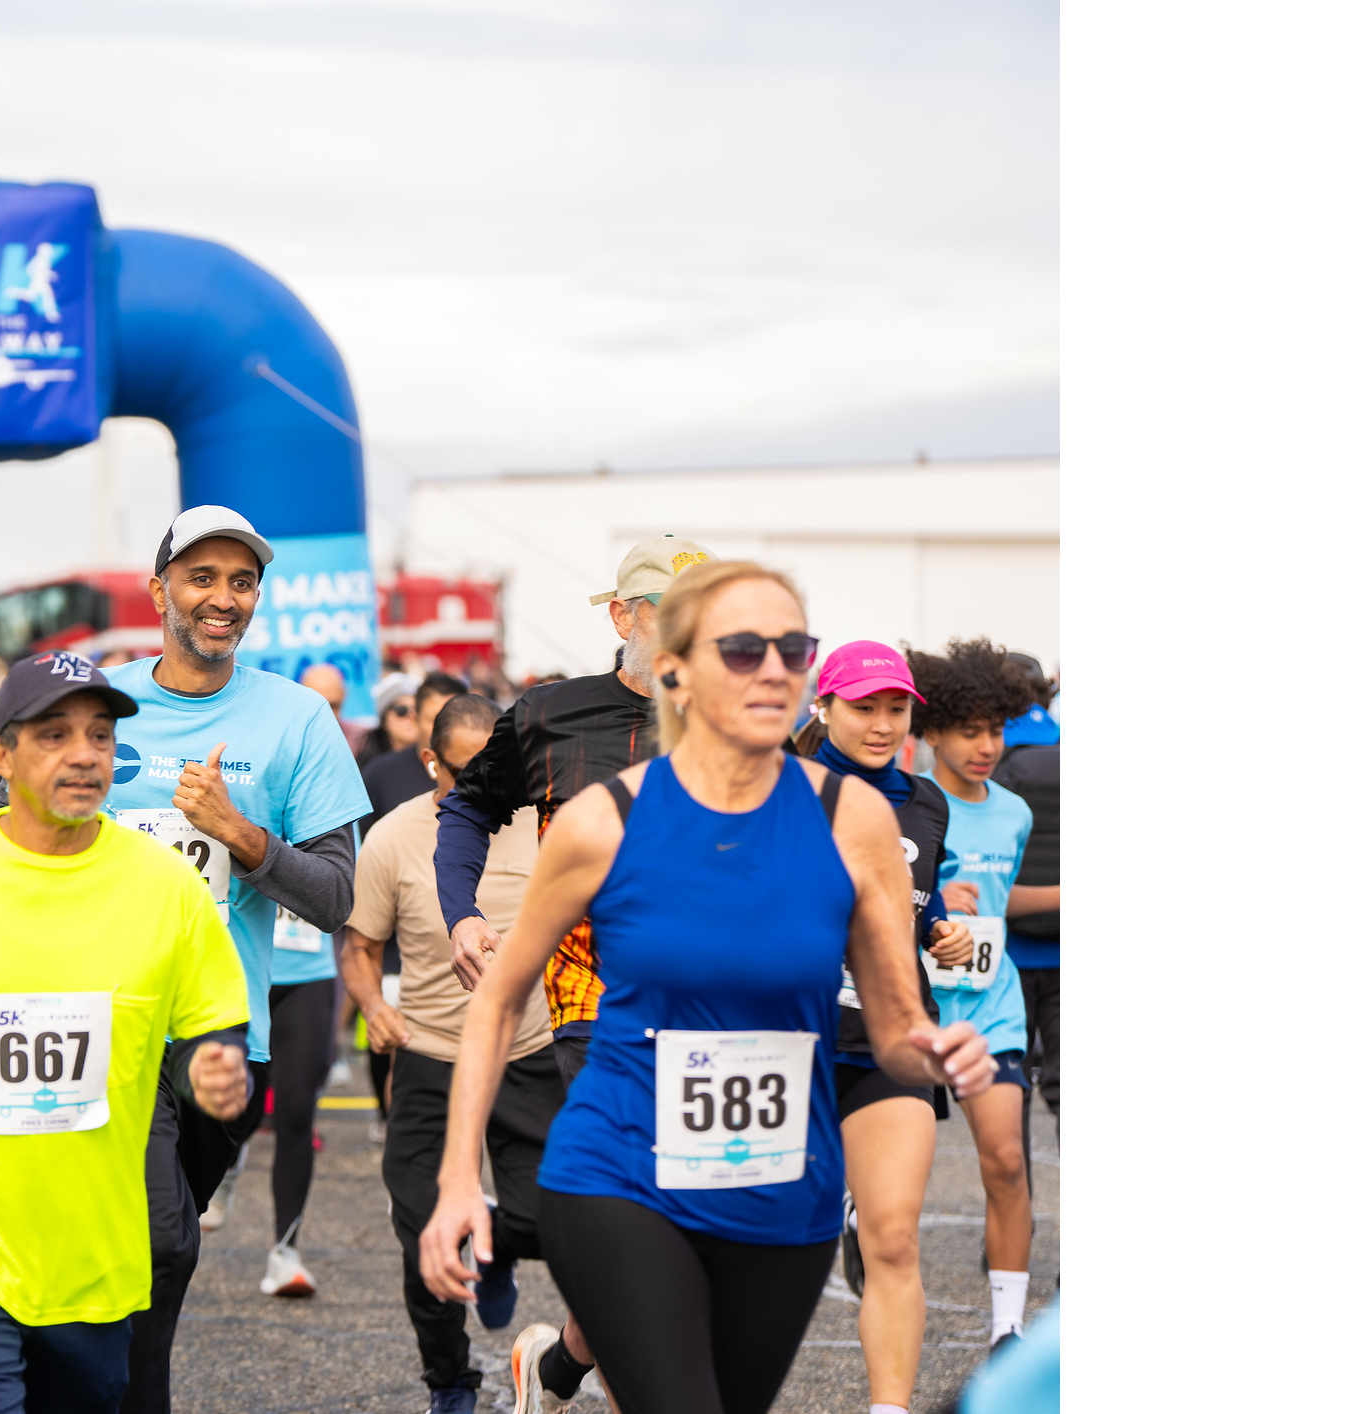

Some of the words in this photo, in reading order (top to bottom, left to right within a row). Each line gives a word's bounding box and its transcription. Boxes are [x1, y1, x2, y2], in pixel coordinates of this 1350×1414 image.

[270, 570, 371, 610] MAKE
[862, 658, 885, 668] RUN
[150, 755, 177, 767] THE
[179, 759, 203, 768] JT
[148, 768, 183, 779] MAD
[239, 774, 256, 786] IT.
[0, 1031, 90, 1083] 667
[686, 1051, 719, 1068] 5K
[682, 1073, 787, 1132] 583
